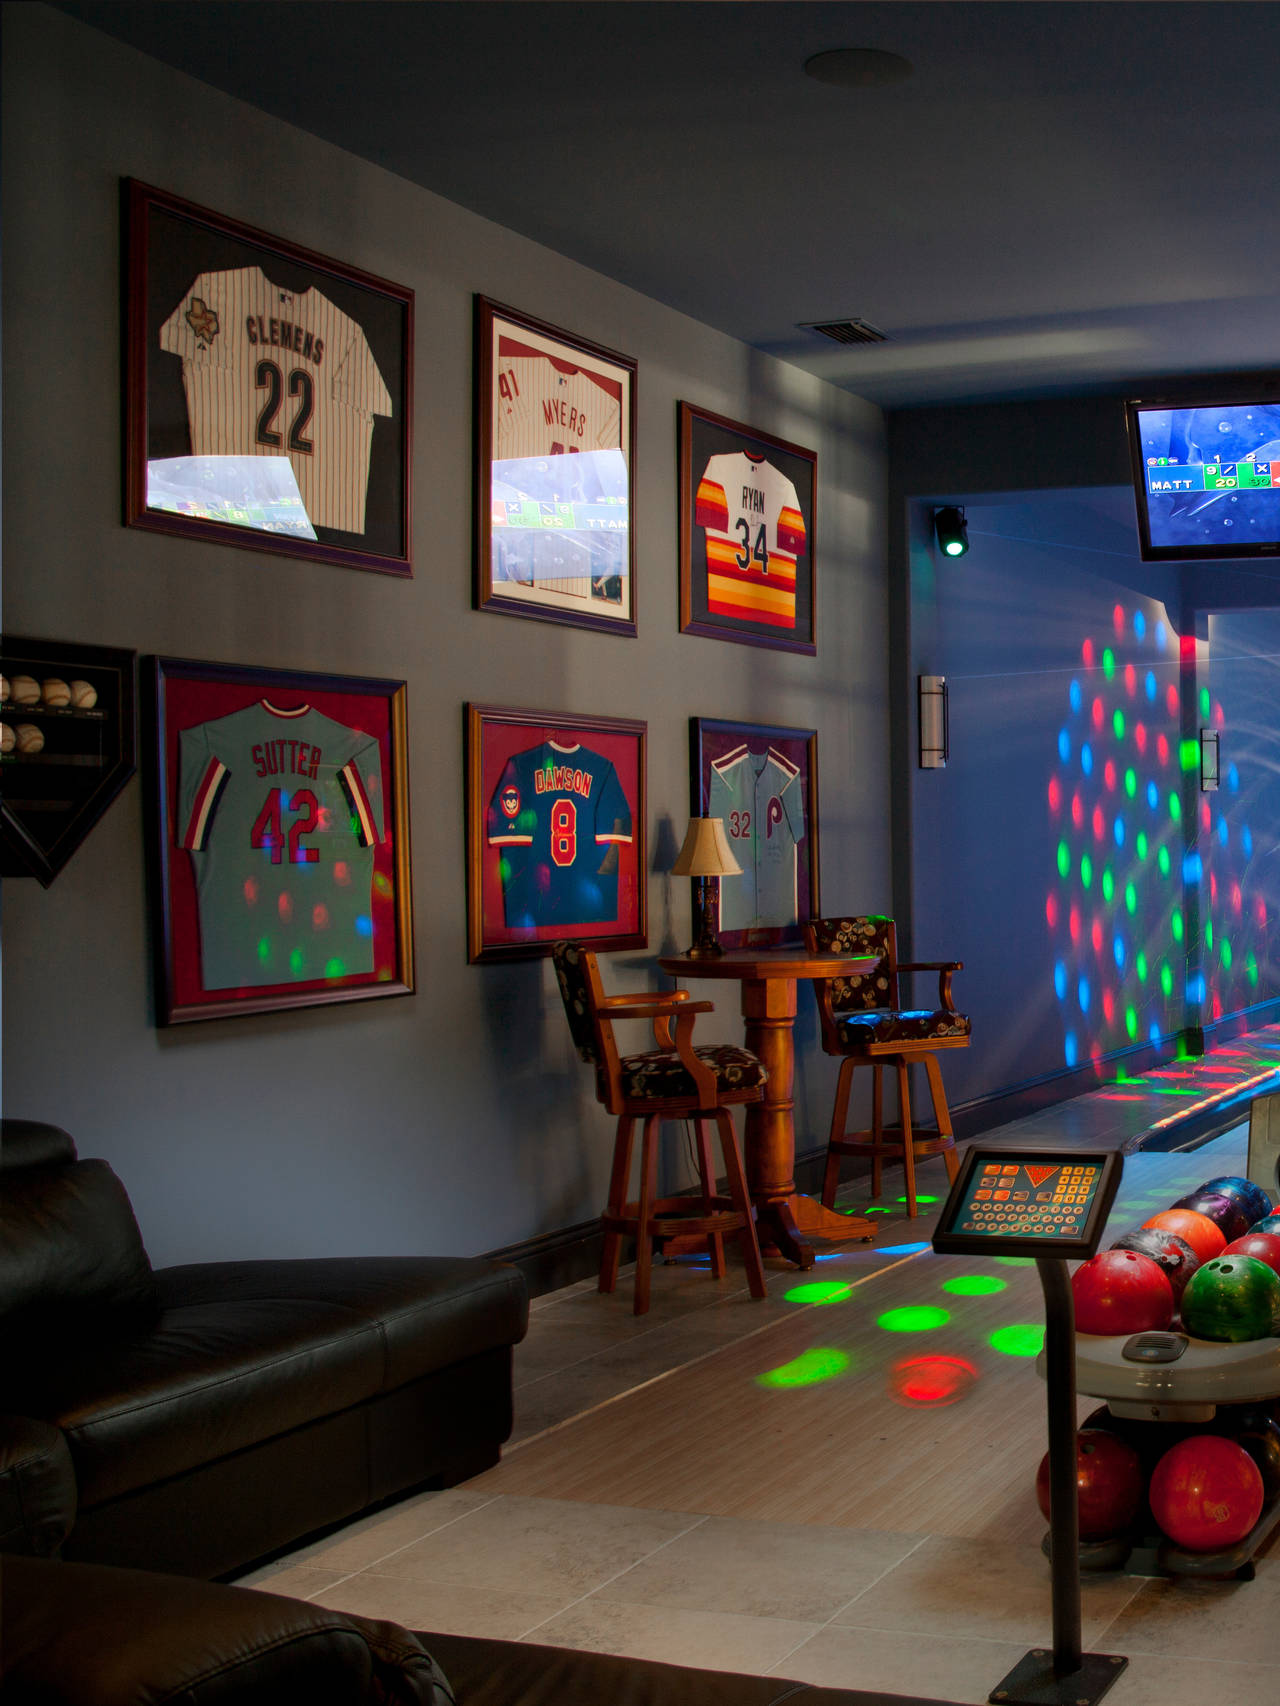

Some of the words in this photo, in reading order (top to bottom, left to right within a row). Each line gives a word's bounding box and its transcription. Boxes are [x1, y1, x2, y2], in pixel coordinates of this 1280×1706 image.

[246, 316, 325, 366] CLEMENS
[499, 369, 519, 402] 41
[255, 359, 315, 456] 22
[542, 398, 586, 437] MYERS
[742, 486, 766, 514] RYAN
[1151, 479, 1193, 490] MATT
[1215, 478, 1236, 487] 20
[735, 517, 769, 575] 34
[252, 739, 323, 781] SUTTER
[534, 765, 594, 800] DAWSON
[251, 787, 321, 865] 42
[550, 798, 577, 867] 8
[730, 810, 752, 839] 32
[766, 795, 783, 840] P
